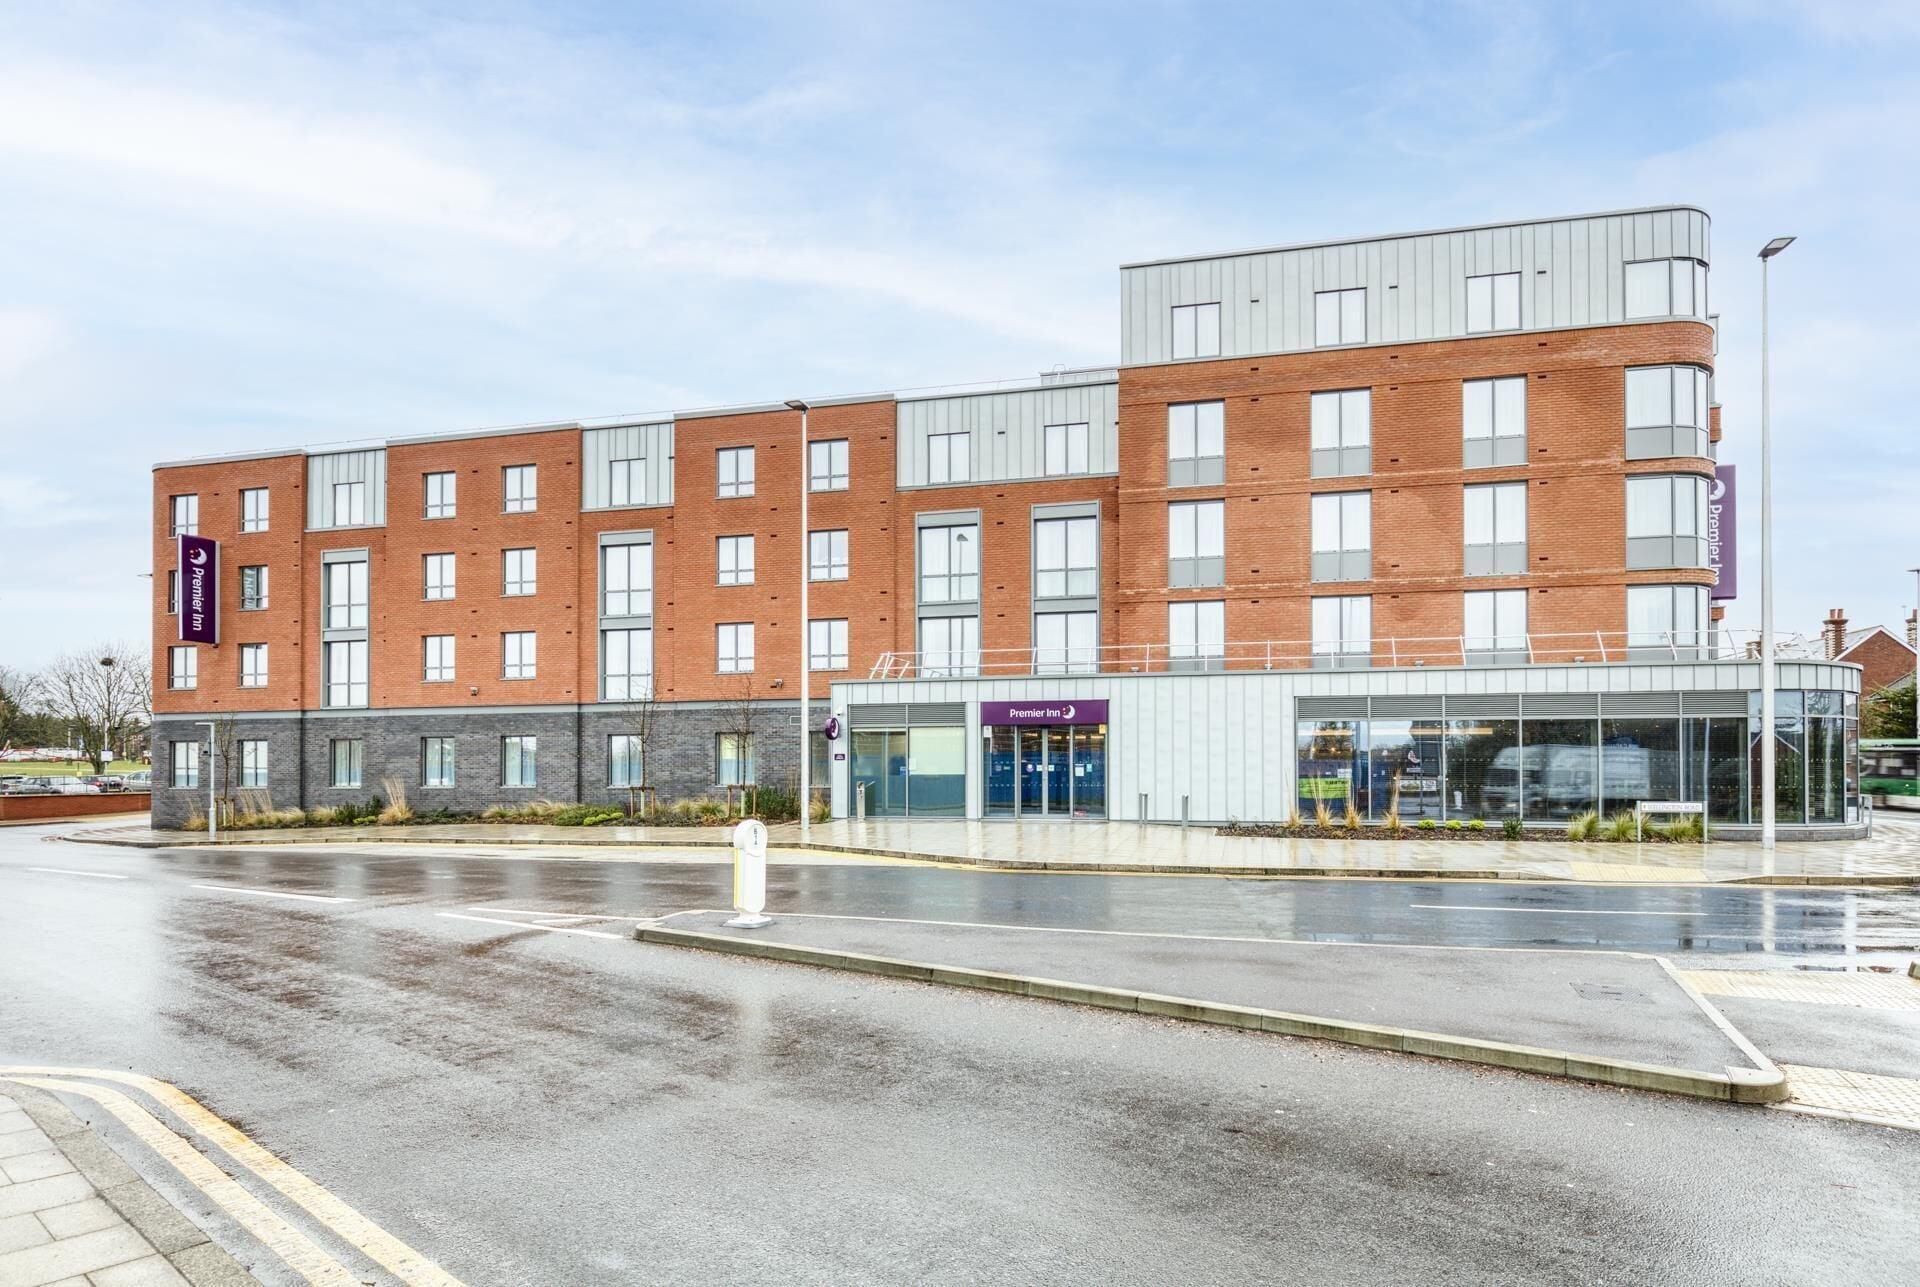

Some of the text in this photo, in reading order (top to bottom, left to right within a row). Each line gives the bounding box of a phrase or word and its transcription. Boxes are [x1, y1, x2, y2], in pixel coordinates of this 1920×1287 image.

[1710, 504, 1723, 561] Premier
[192, 567, 204, 631] Premier Inn
[1009, 708, 1060, 718] Premier Inn
